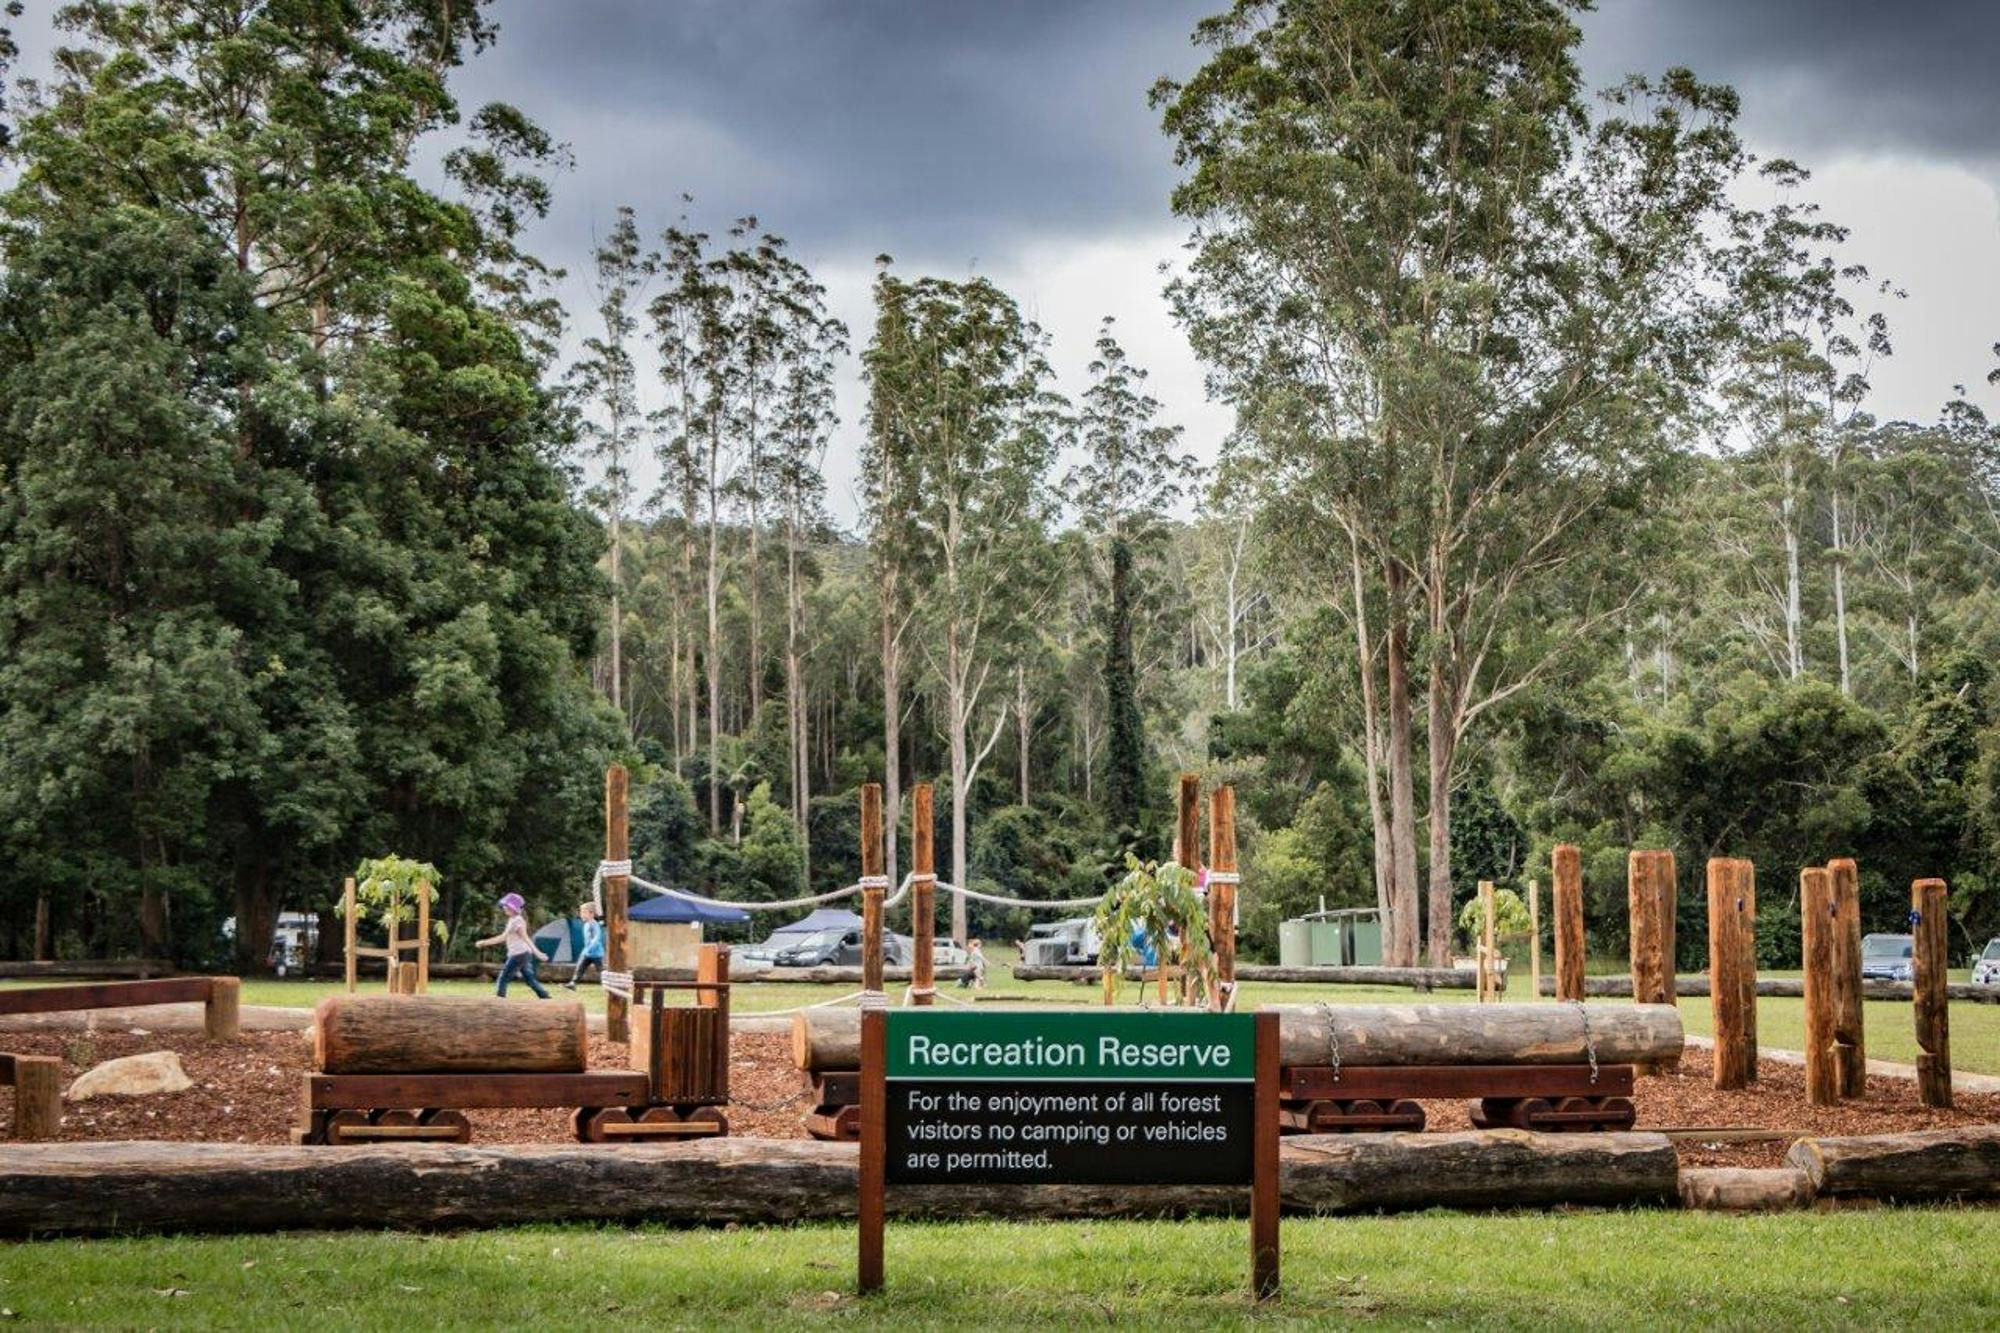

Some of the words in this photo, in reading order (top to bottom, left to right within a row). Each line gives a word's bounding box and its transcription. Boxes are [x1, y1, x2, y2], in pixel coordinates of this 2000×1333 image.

[909, 1035, 1085, 1066] Recreation
[1099, 1036, 1231, 1066] Reserve
[908, 1091, 941, 1111] For
[948, 1092, 981, 1111] the
[988, 1092, 1098, 1115] enjoyment
[1105, 1092, 1125, 1111] of
[1132, 1092, 1153, 1112] all
[1160, 1092, 1221, 1112] forest
[907, 1119, 982, 1140] visitors
[989, 1125, 1015, 1140] no
[1021, 1120, 1109, 1143] camping
[1116, 1126, 1137, 1140] or
[1144, 1120, 1227, 1141] vehicles
[907, 1153, 940, 1168] are
[947, 1149, 1053, 1171] permitted.
